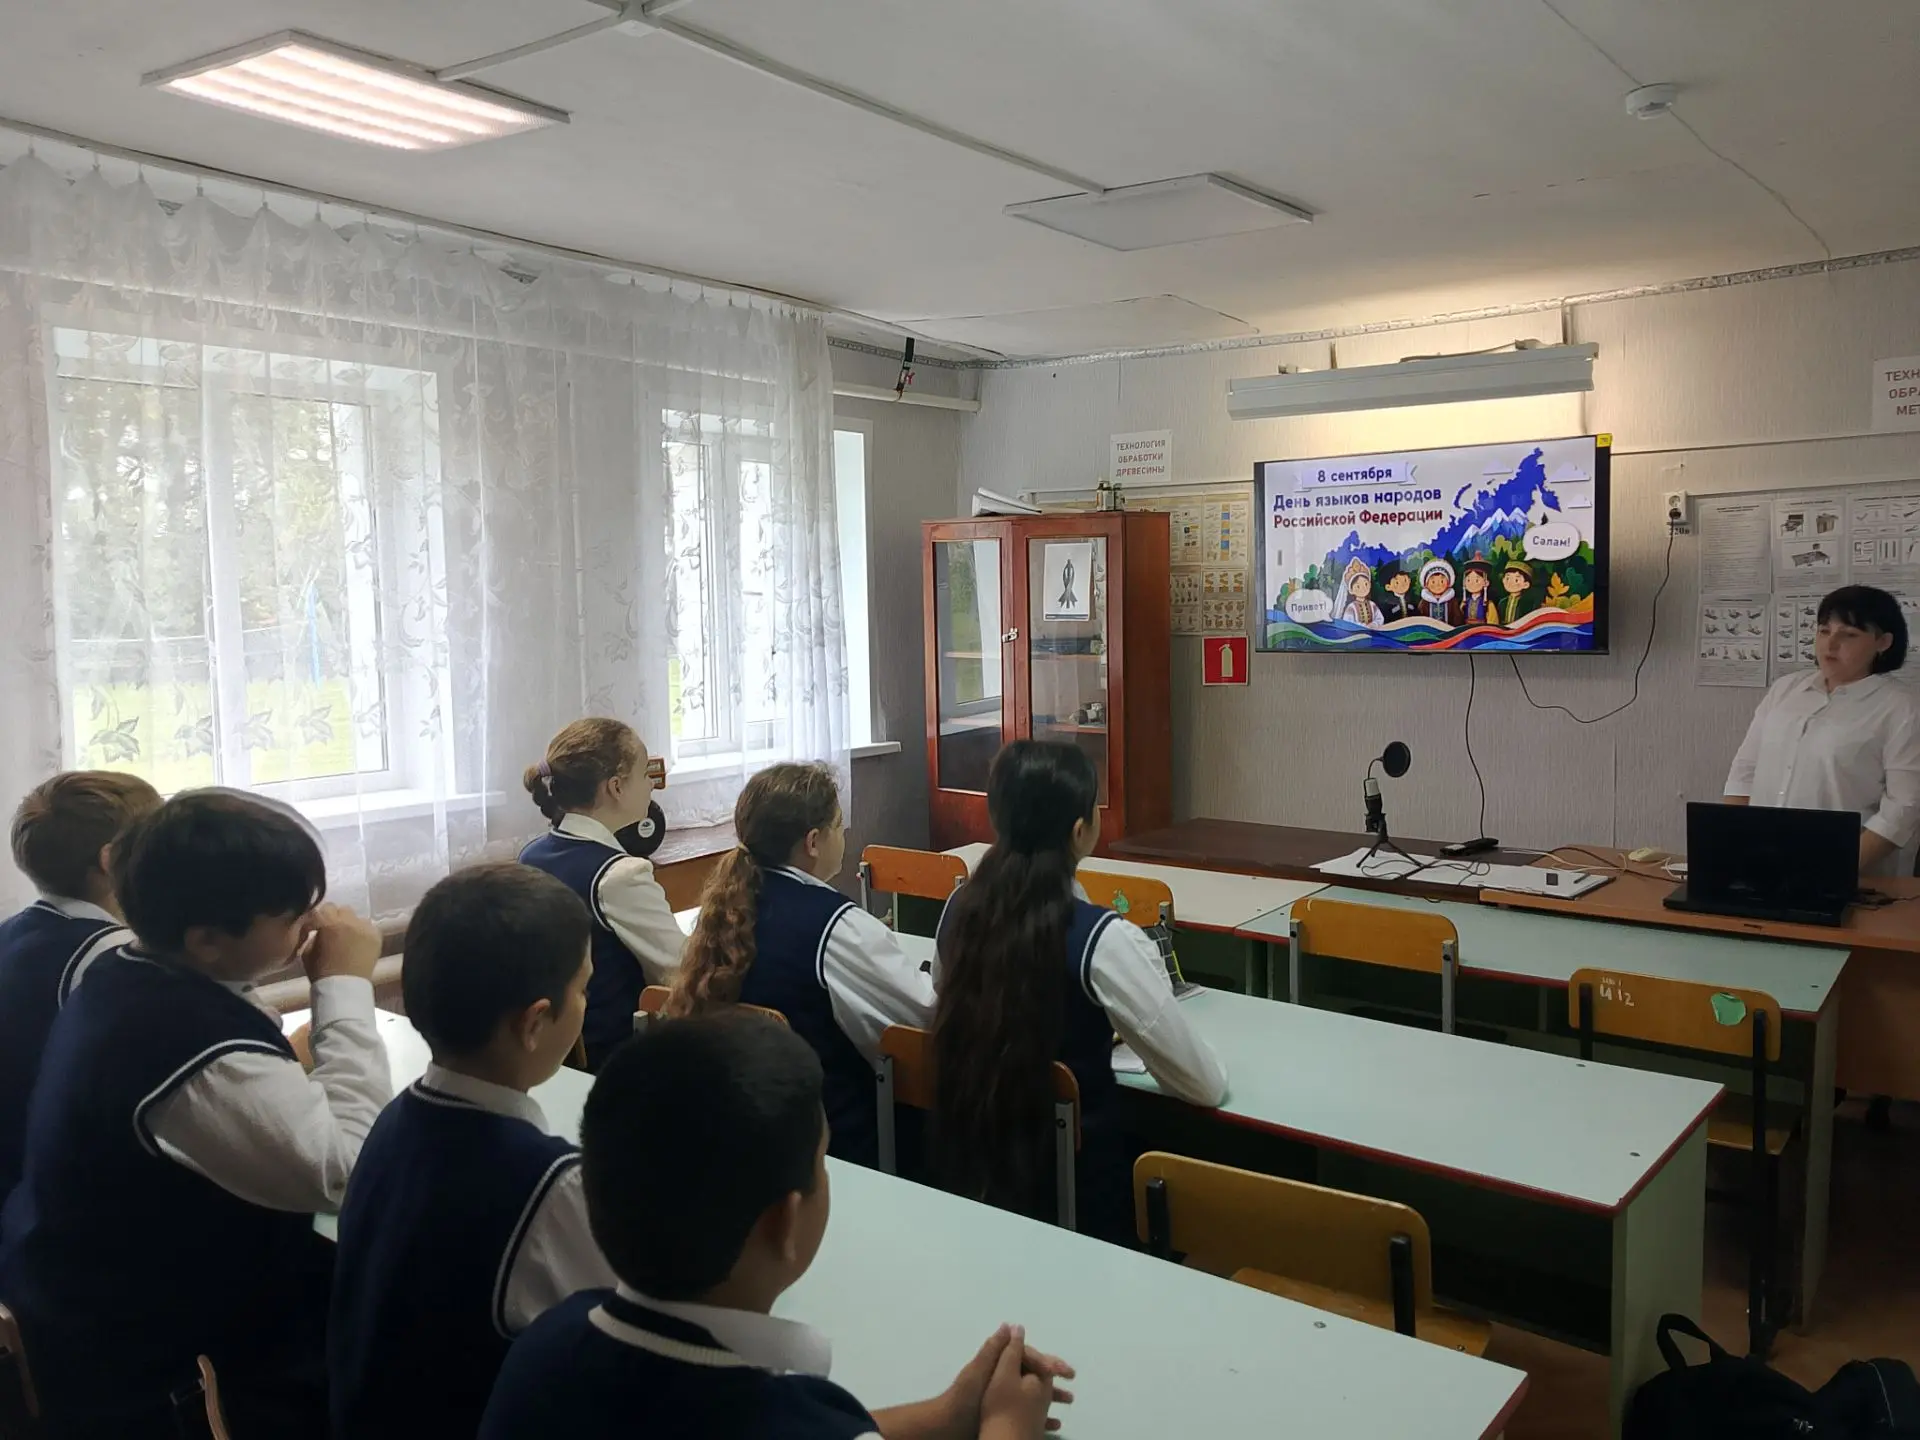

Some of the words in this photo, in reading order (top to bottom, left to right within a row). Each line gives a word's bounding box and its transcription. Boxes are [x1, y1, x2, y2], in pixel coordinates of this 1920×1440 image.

[1885, 368, 1920, 381] ТЕХН
[1889, 386, 1920, 399] ОБР
[1116, 440, 1166, 451] ТЕХНОЛОГИЯ
[1118, 453, 1164, 464] ОБРАБОТКИ
[1115, 466, 1165, 477] ДРЕВЕСИНЫ
[1317, 470, 1326, 483] 8
[1331, 467, 1392, 482] сентября
[1273, 494, 1311, 512] День
[1315, 492, 1369, 508] языков
[1374, 488, 1442, 506] народов
[1274, 512, 1356, 528] Российской
[1359, 509, 1443, 524] Федерации
[1291, 602, 1327, 613] Привет!
